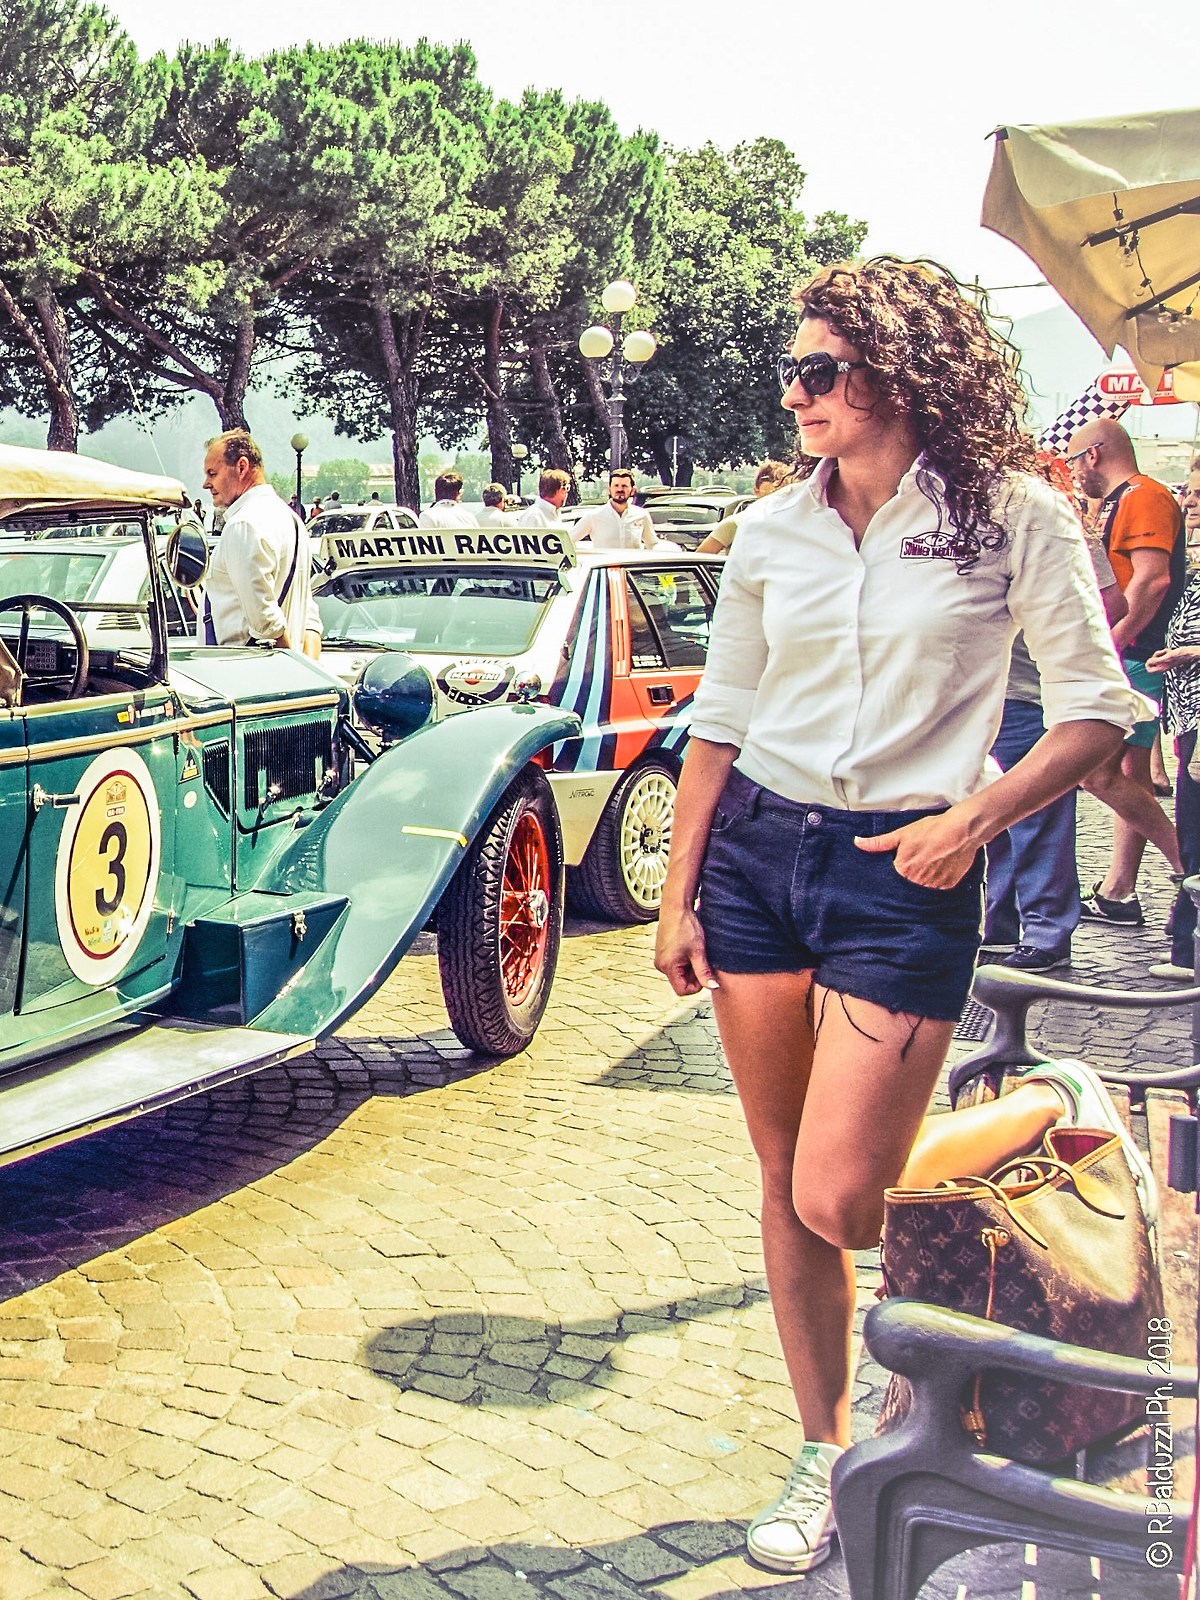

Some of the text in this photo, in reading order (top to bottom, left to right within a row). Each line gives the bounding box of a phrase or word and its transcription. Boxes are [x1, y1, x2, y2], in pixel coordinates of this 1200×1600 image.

[335, 533, 564, 559] MARTINI RACING
[450, 671, 501, 681] MARTINI
[95, 821, 127, 917] 3
